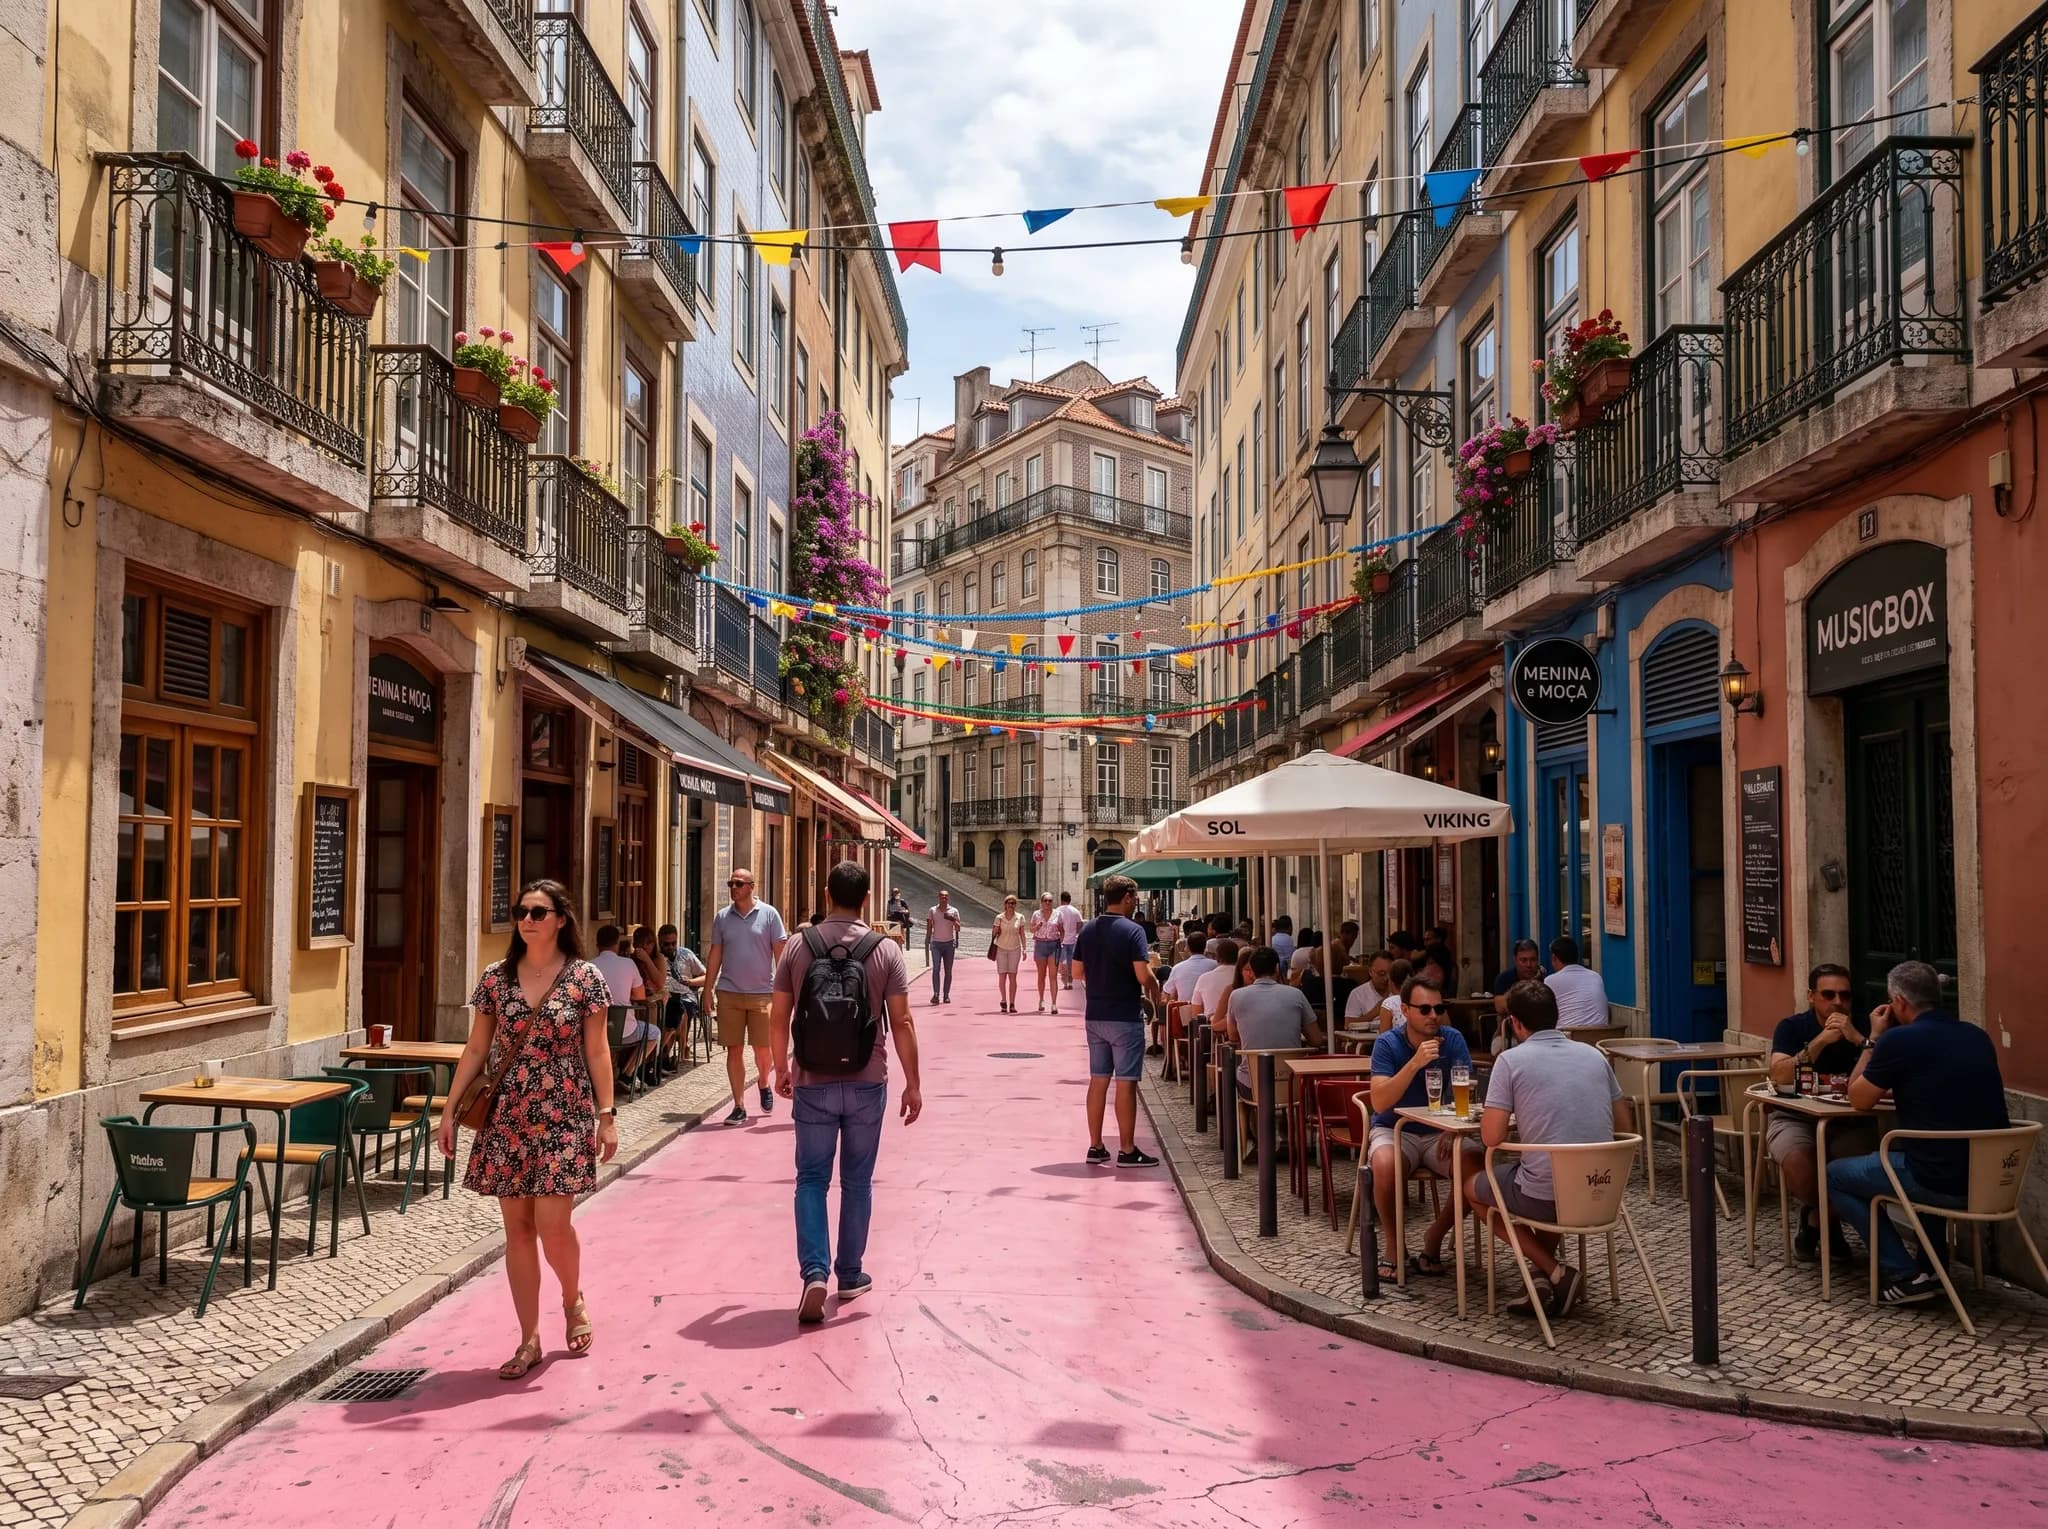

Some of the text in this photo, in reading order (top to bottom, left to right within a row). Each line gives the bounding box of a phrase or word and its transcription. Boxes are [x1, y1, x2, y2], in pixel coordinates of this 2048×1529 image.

[1817, 582, 1935, 655] MUSICBOX
[1524, 666, 1591, 681] MENINA
[402, 685, 407, 704] E
[409, 687, 432, 714] MOÇA
[1527, 685, 1588, 703] e MOÇA
[1207, 820, 1246, 836] SOL
[1423, 812, 1491, 829] VIKING
